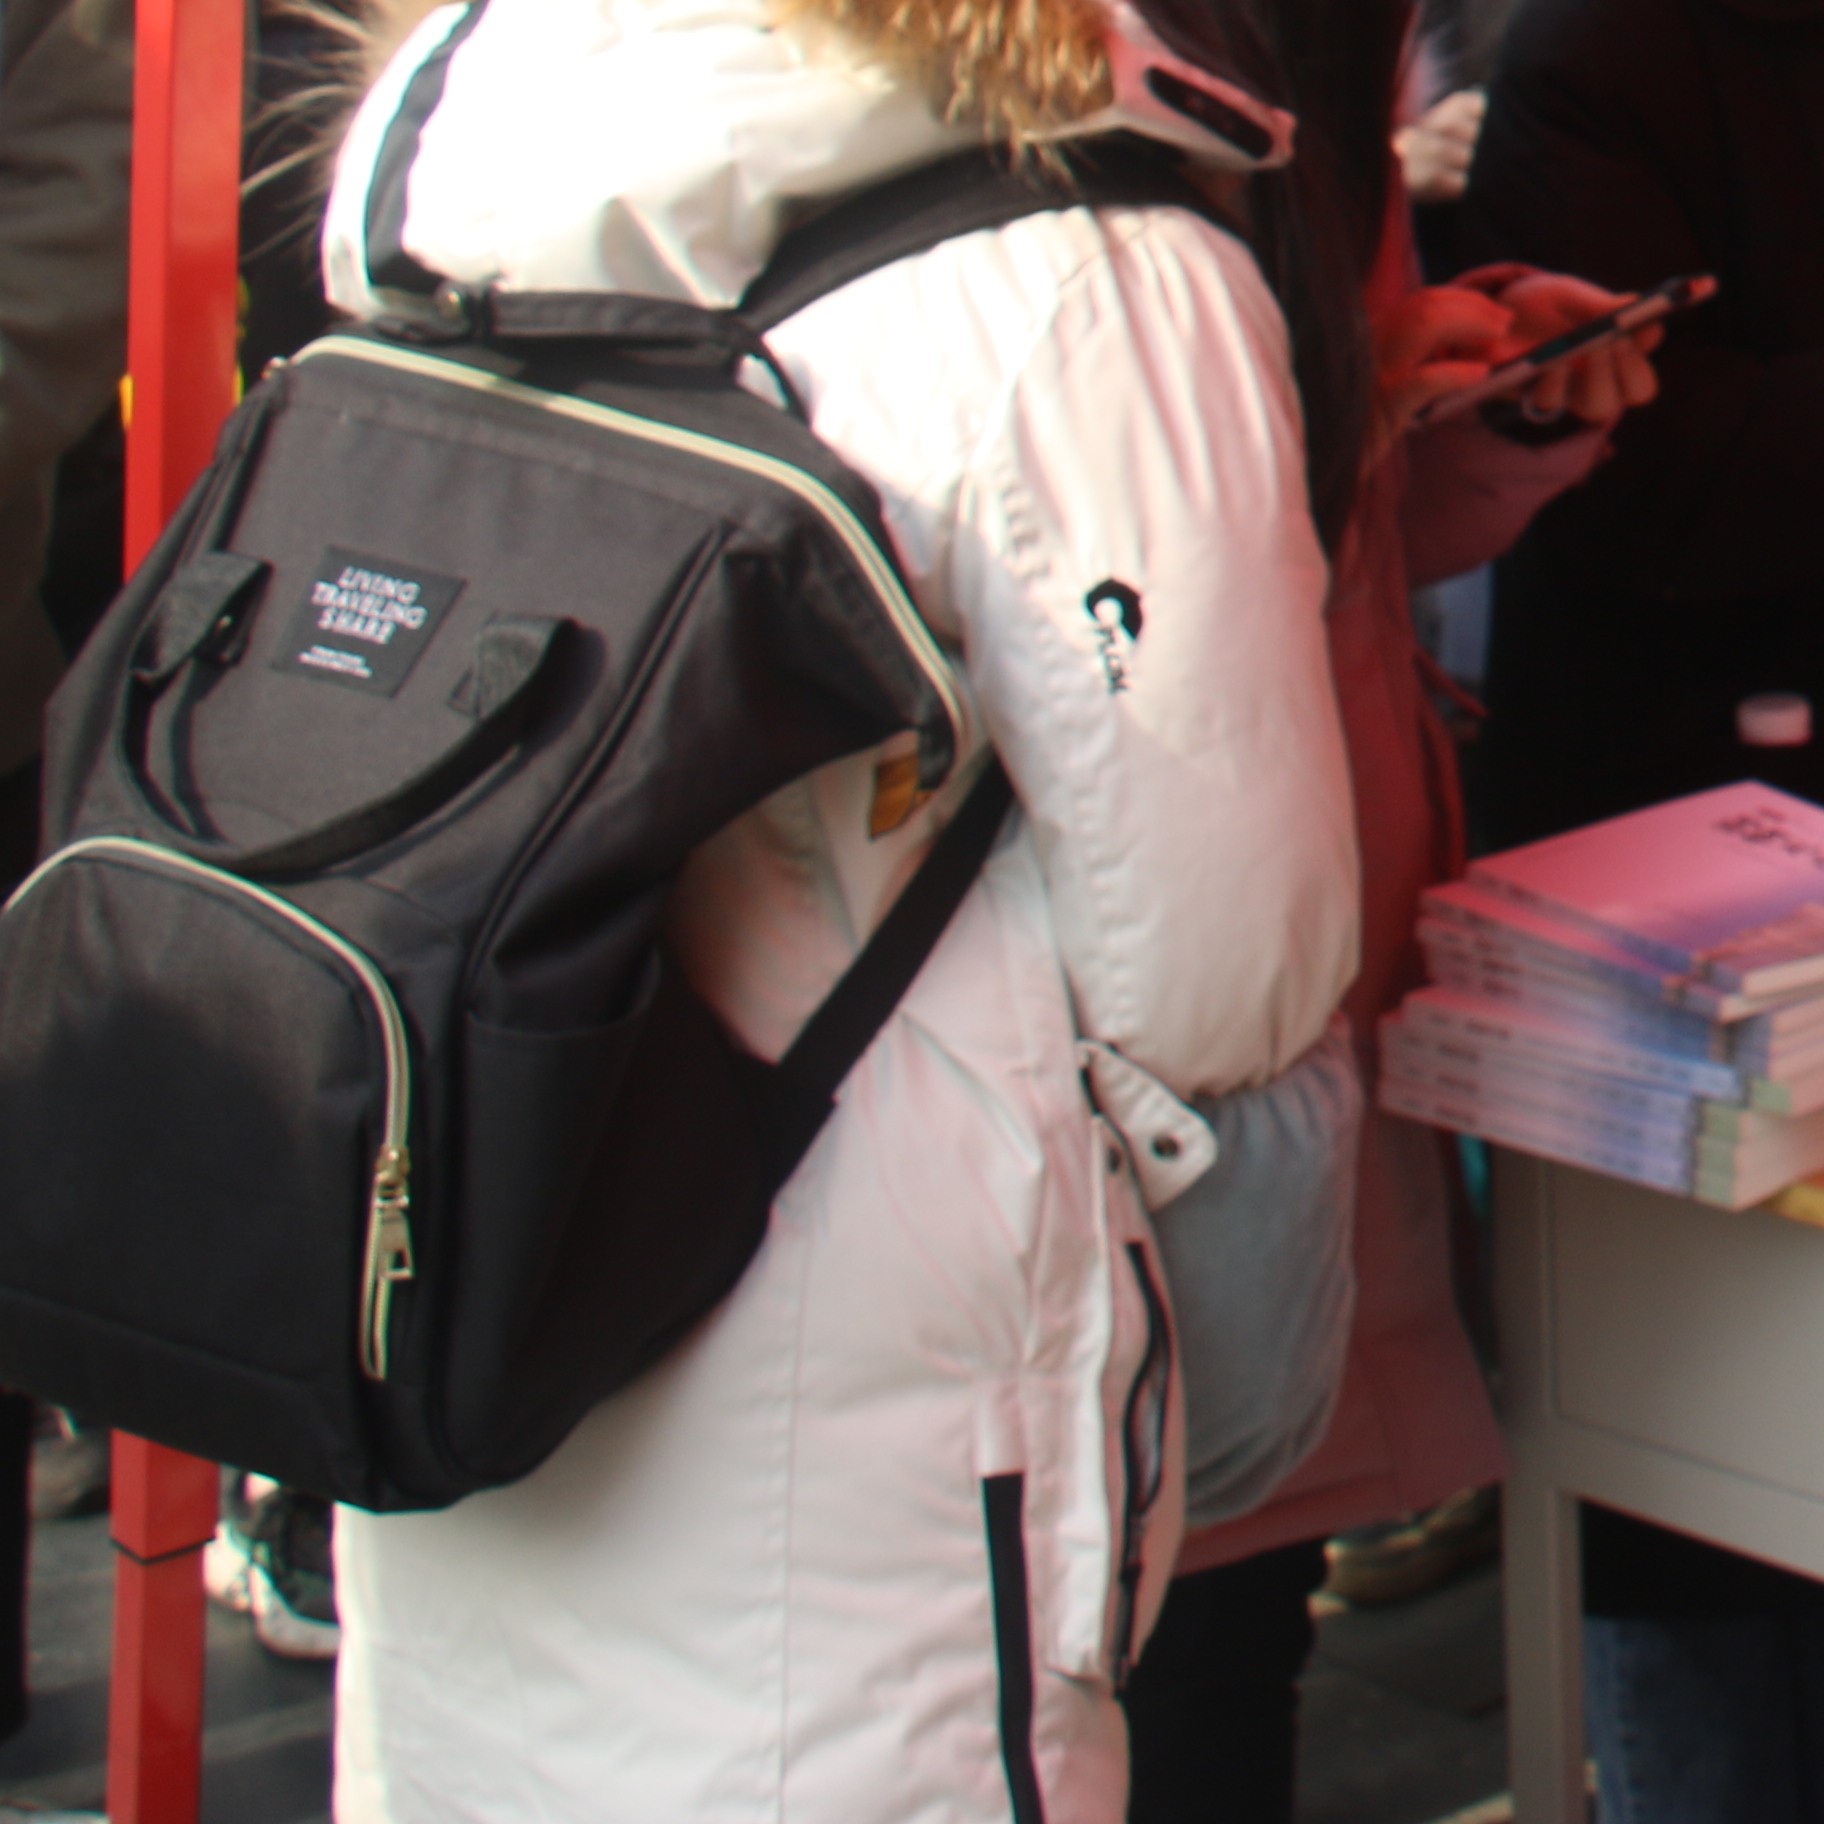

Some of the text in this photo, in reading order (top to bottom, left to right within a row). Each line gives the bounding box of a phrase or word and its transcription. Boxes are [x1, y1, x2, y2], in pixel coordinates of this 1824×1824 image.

[310, 580, 428, 630] TRAVELING
[337, 565, 421, 605] LIVING
[318, 607, 397, 645] SHARE
